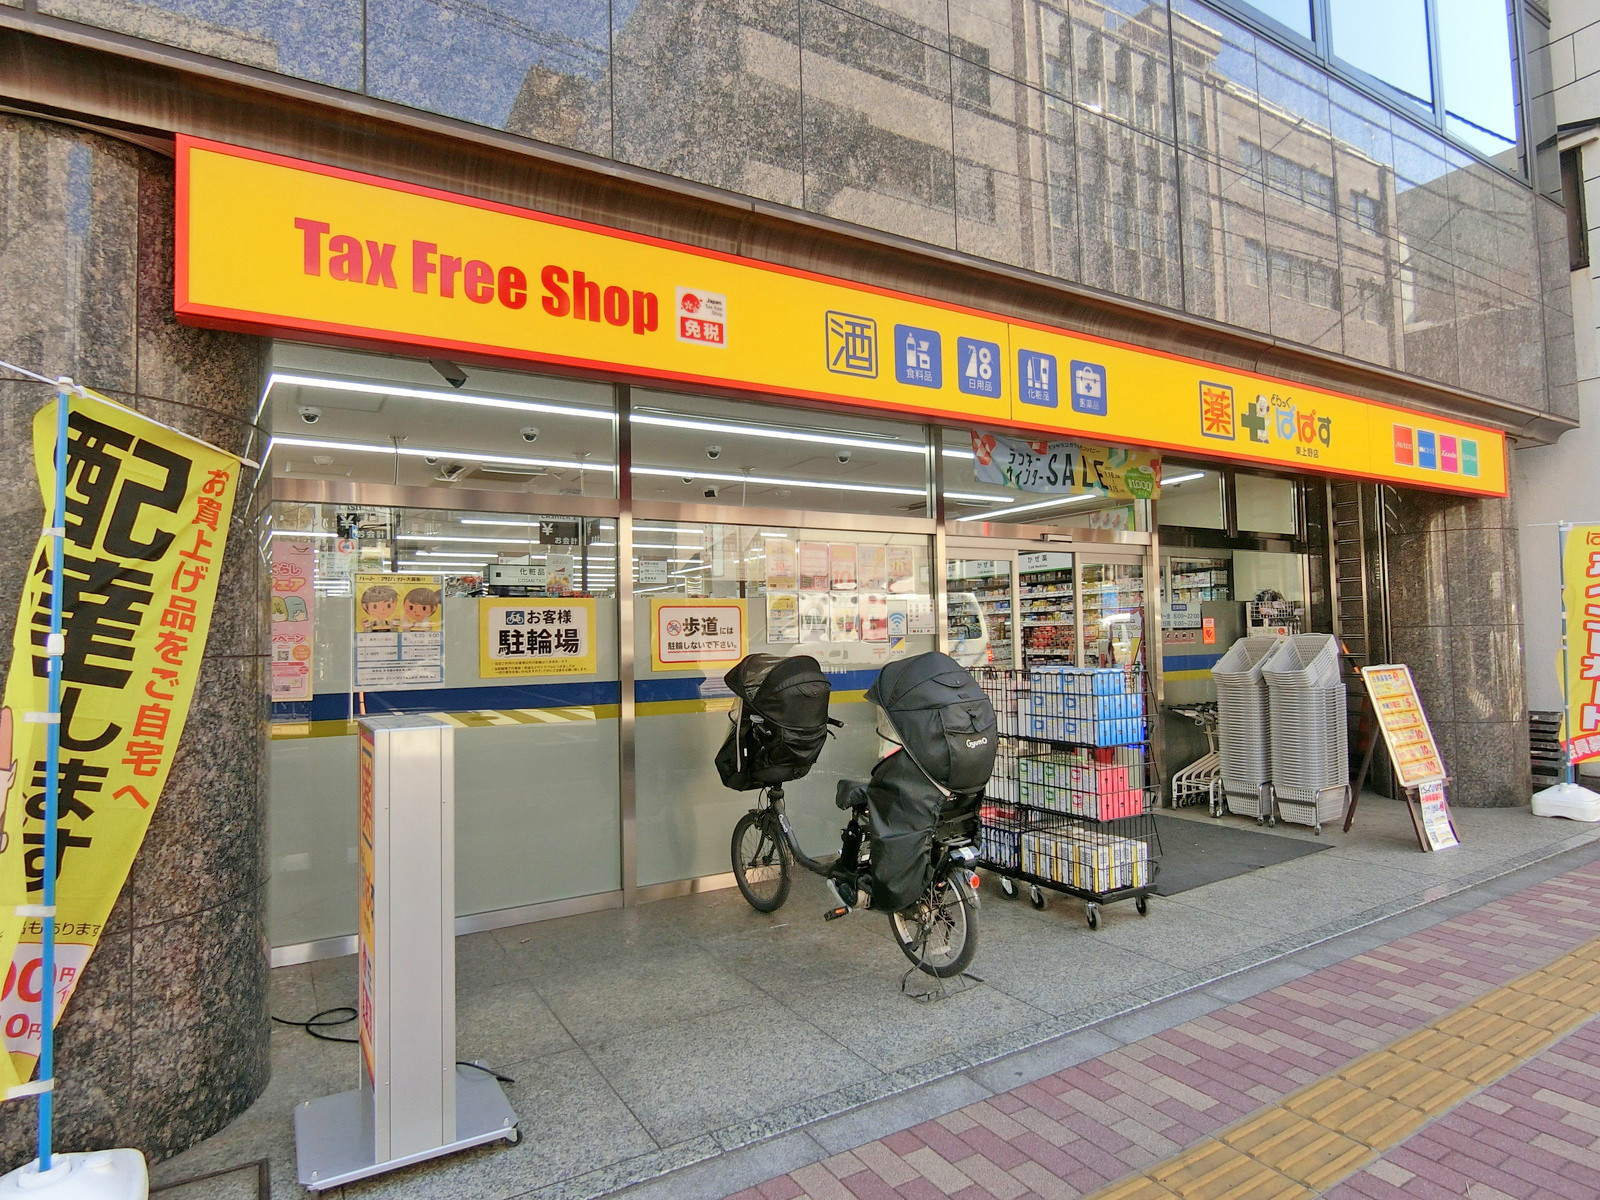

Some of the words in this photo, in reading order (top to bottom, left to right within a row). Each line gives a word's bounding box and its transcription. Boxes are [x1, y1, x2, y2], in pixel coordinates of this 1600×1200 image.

[294, 217, 397, 289] Tax
[412, 239, 527, 309] Free
[542, 264, 659, 335] Shop
[684, 319, 720, 342] 免税
[831, 318, 873, 372] 酒
[906, 367, 933, 382] 食料品
[968, 378, 993, 393] 日用品
[1027, 389, 1050, 402] 化粧品
[1204, 388, 1232, 435] 薬
[1046, 453, 1109, 490] SALE
[555, 537, 578, 545] お会計
[519, 568, 546, 576] 化粧品
[527, 609, 572, 624] お客様
[682, 617, 733, 637] 歩道には
[112, 469, 230, 810] お買上げ品をご自宅へ
[498, 628, 579, 655] 駐輪場
[667, 641, 738, 651] 駐輪しないで下さい。
[24, 410, 193, 893] 配達します
